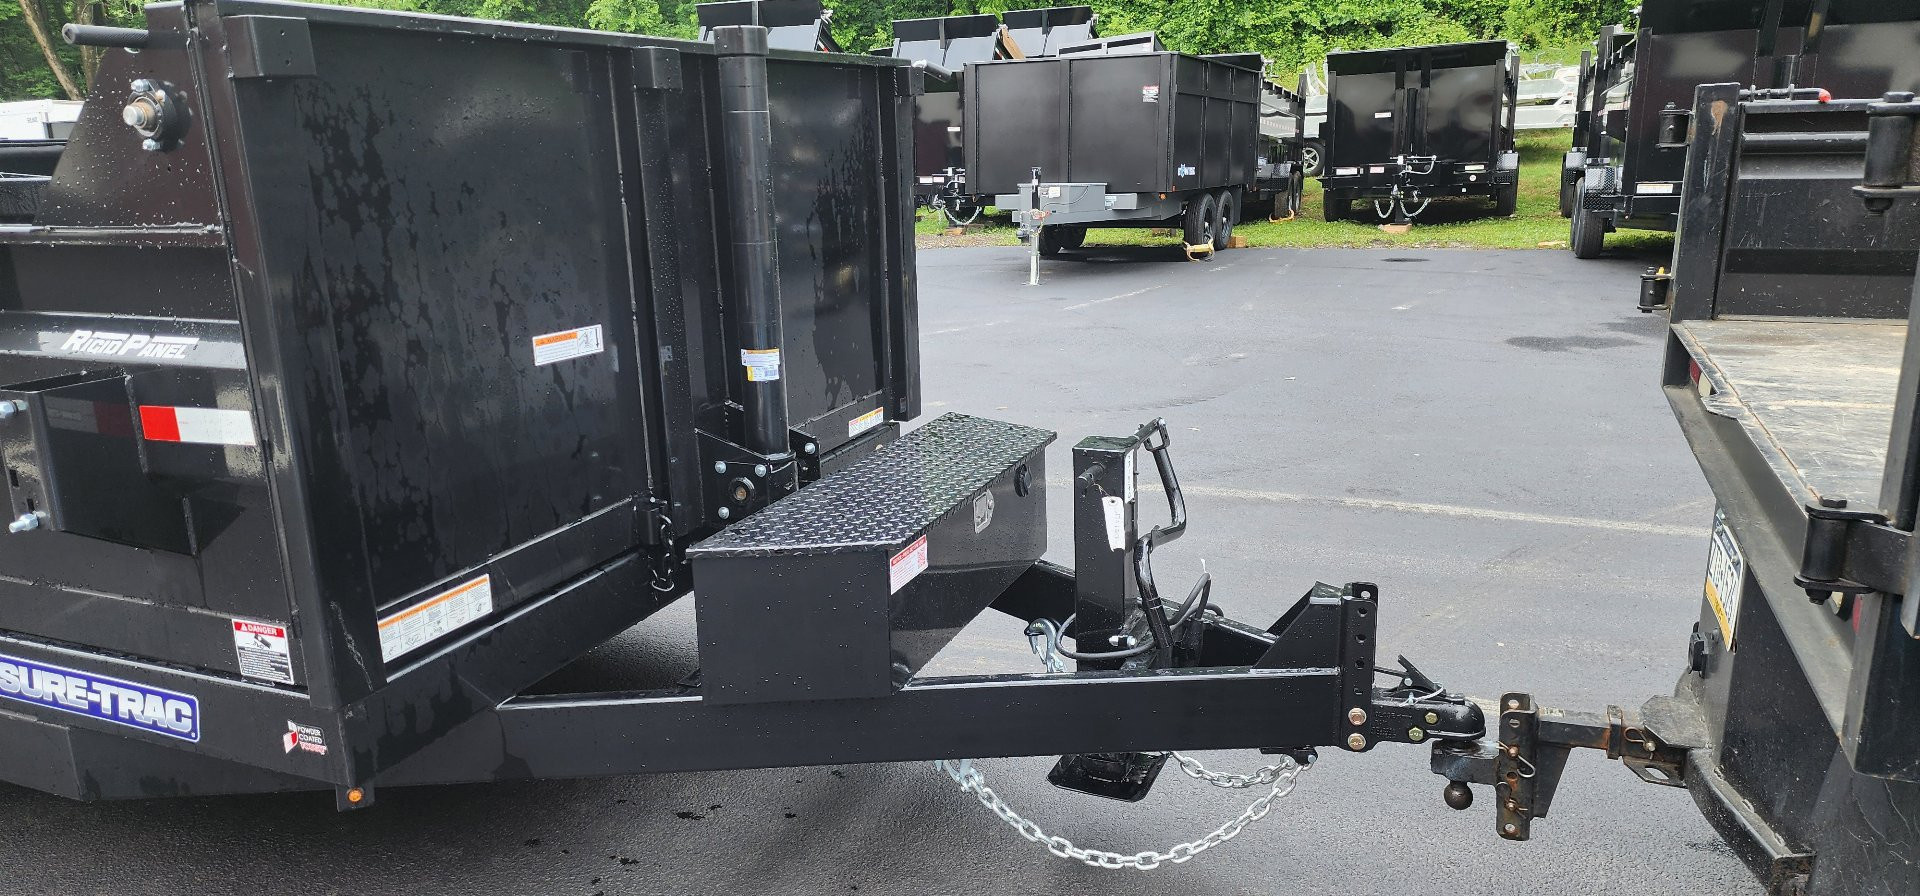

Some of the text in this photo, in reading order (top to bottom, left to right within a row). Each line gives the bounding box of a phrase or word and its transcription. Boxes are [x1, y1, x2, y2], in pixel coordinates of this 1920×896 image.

[247, 624, 277, 635] DANGER
[0, 661, 193, 733] SURE-TRAC
[297, 726, 322, 737] POWDER
[298, 733, 323, 744] COATED
